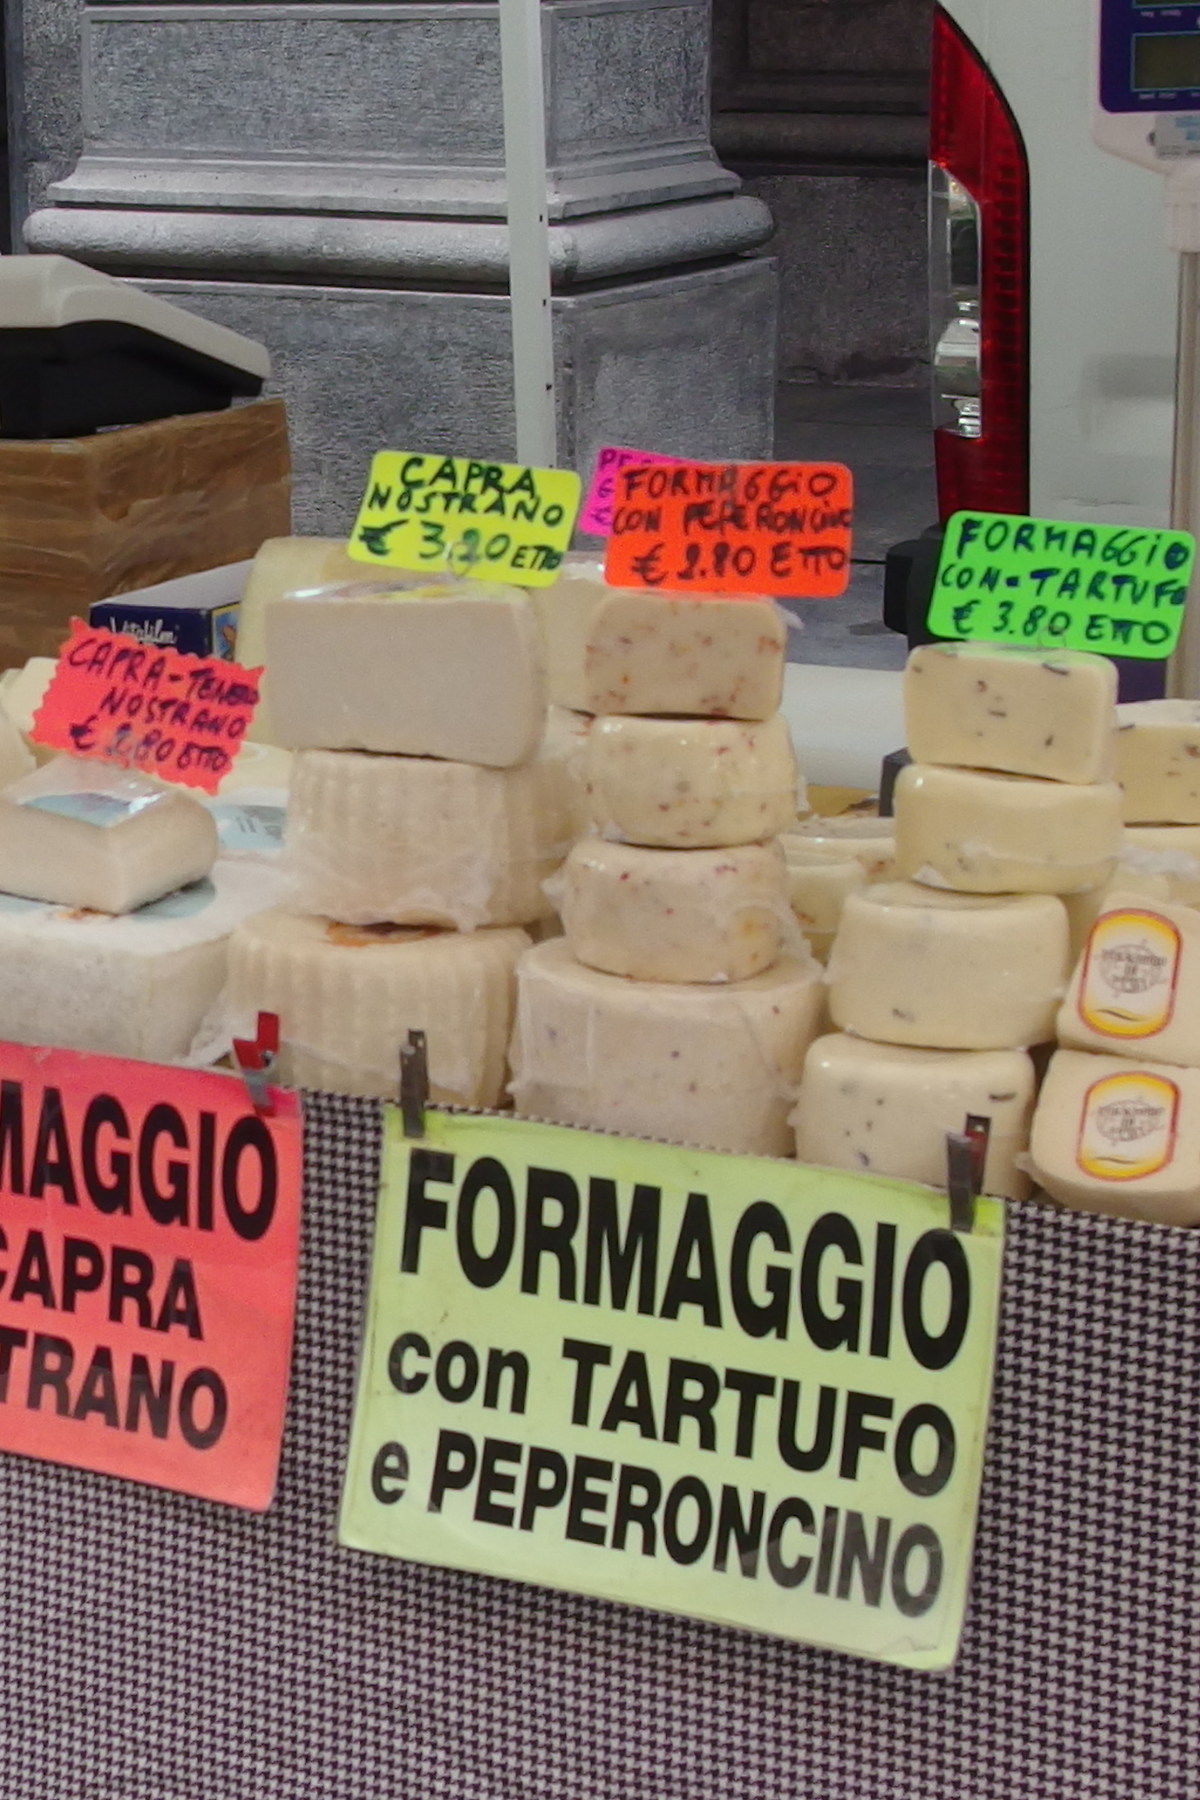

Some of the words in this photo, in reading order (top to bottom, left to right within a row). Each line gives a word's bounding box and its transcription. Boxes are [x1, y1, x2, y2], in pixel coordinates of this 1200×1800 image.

[367, 482, 564, 528] NOSTRANO
[399, 456, 536, 500] CAPRA
[612, 506, 662, 535] CON
[99, 686, 247, 740] NOSTRANO
[400, 1146, 972, 1371] FORMAGGIO
[387, 1331, 530, 1416] con
[561, 1337, 958, 1499] TARTUFO
[370, 1440, 410, 1506] e
[426, 1427, 946, 1619] PEPERONCINO
